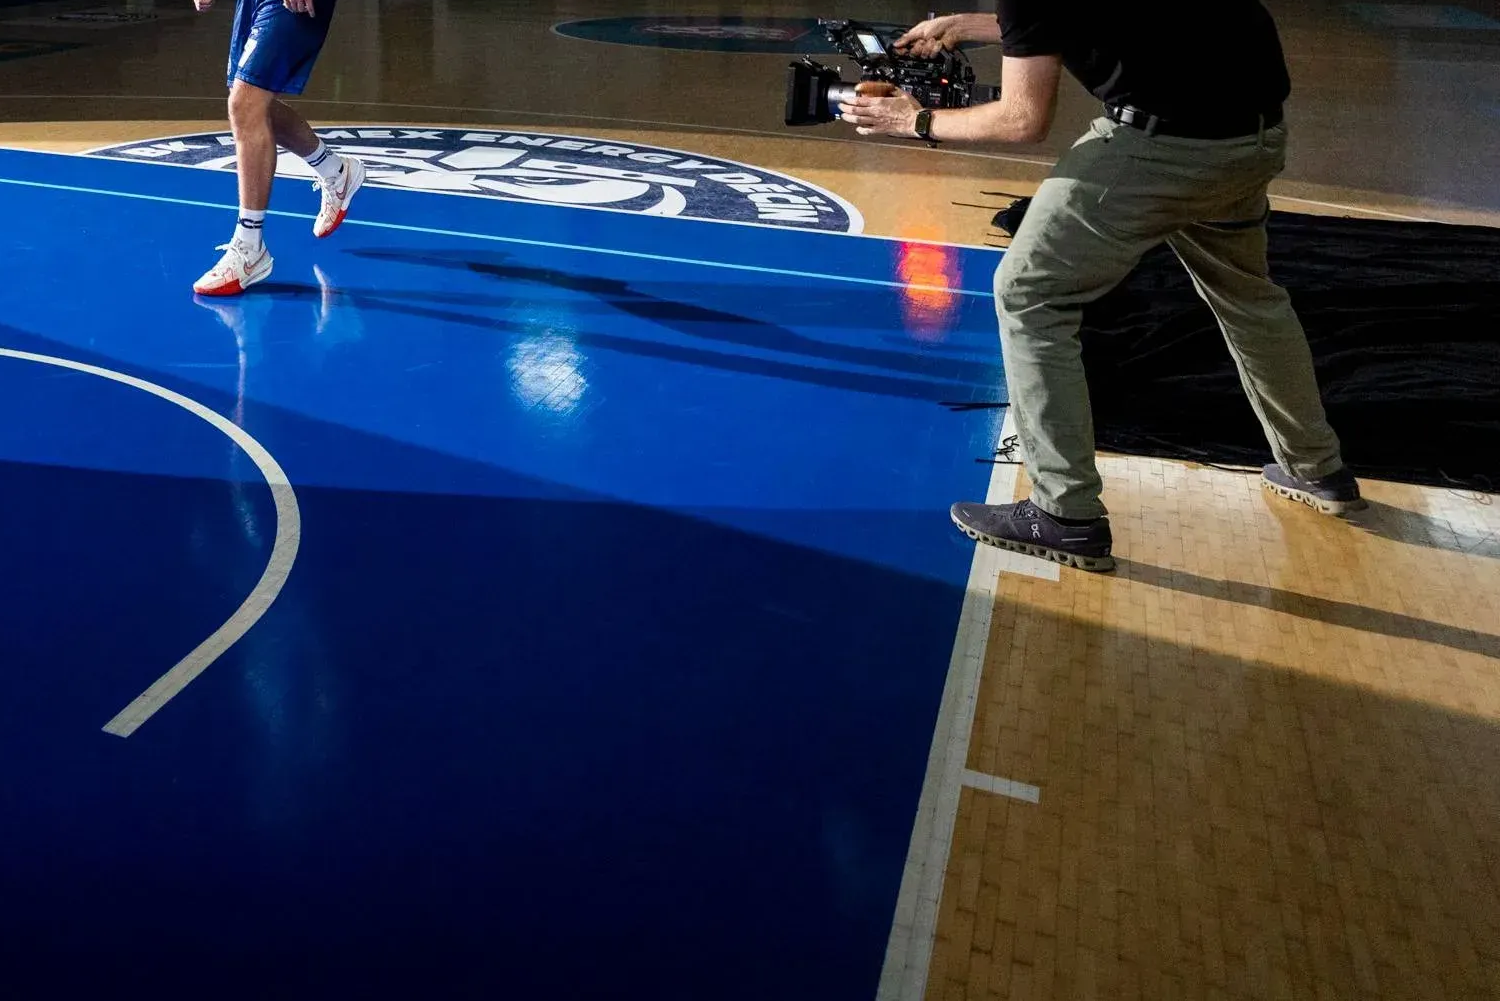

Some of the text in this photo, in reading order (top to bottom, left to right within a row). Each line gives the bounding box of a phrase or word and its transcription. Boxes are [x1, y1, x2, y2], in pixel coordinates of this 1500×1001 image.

[119, 140, 212, 158] BK
[459, 132, 716, 171] ENERGY
[701, 172, 835, 224] DĚČÍN
